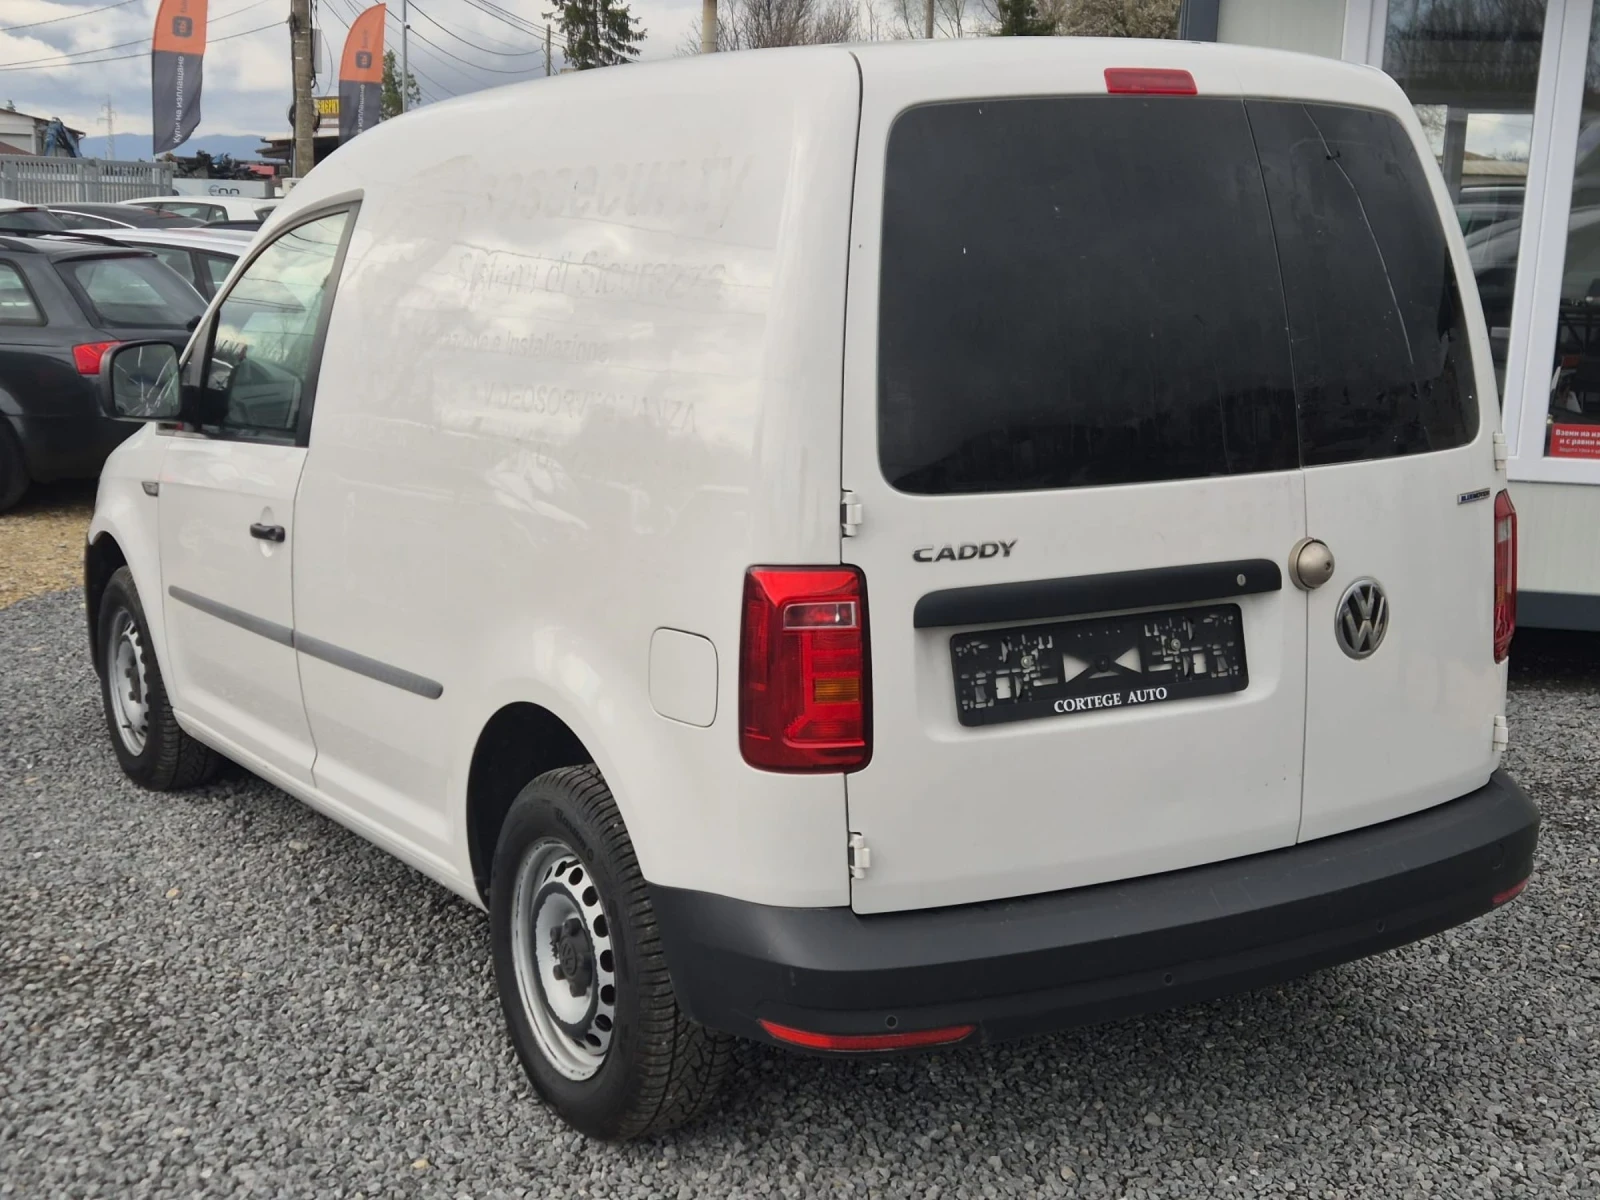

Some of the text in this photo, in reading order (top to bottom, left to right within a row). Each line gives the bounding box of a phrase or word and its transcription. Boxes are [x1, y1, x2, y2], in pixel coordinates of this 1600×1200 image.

[173, 55, 185, 143] Купи на изплащане
[913, 539, 1018, 563] CADDY
[1054, 687, 1168, 713] CORTEGE AUTO
